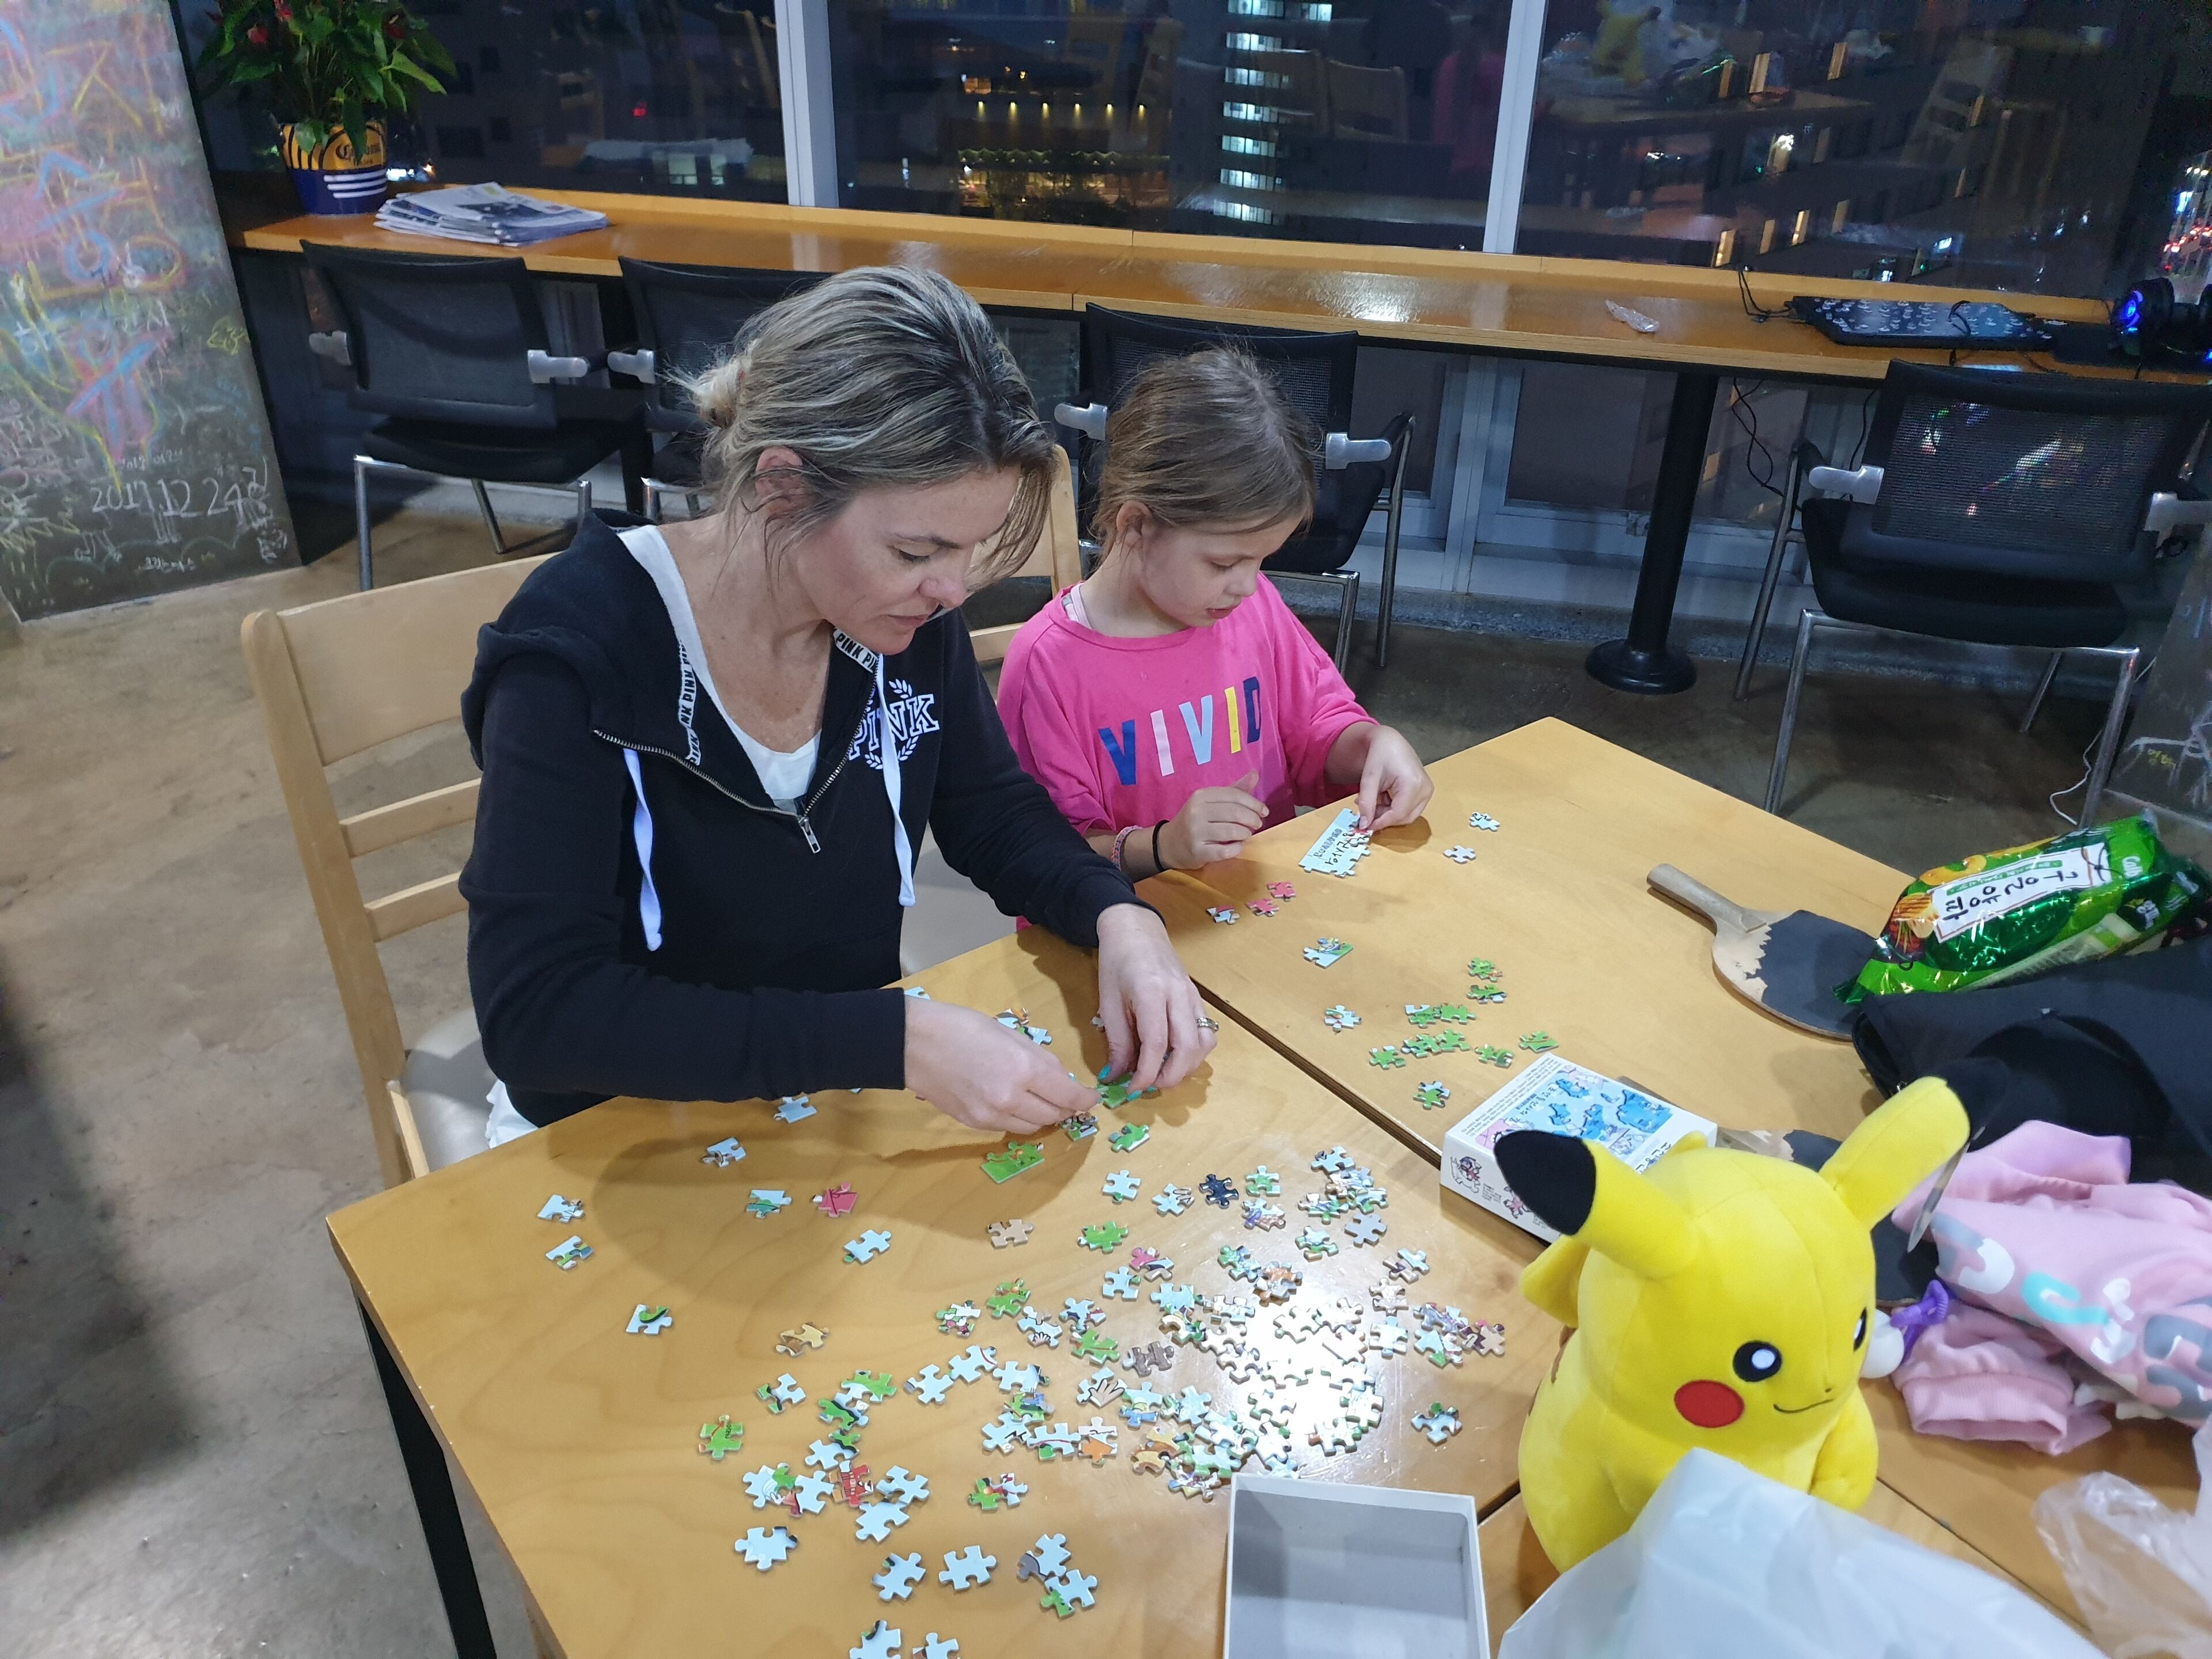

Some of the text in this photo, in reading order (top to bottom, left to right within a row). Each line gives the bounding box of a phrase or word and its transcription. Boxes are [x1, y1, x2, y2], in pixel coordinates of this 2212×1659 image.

[836, 632, 864, 659] PINK
[680, 704, 693, 725] NK
[849, 694, 940, 761] PINK
[1098, 676, 1262, 786] VIVID
[1942, 870, 2078, 921] 구운양파
